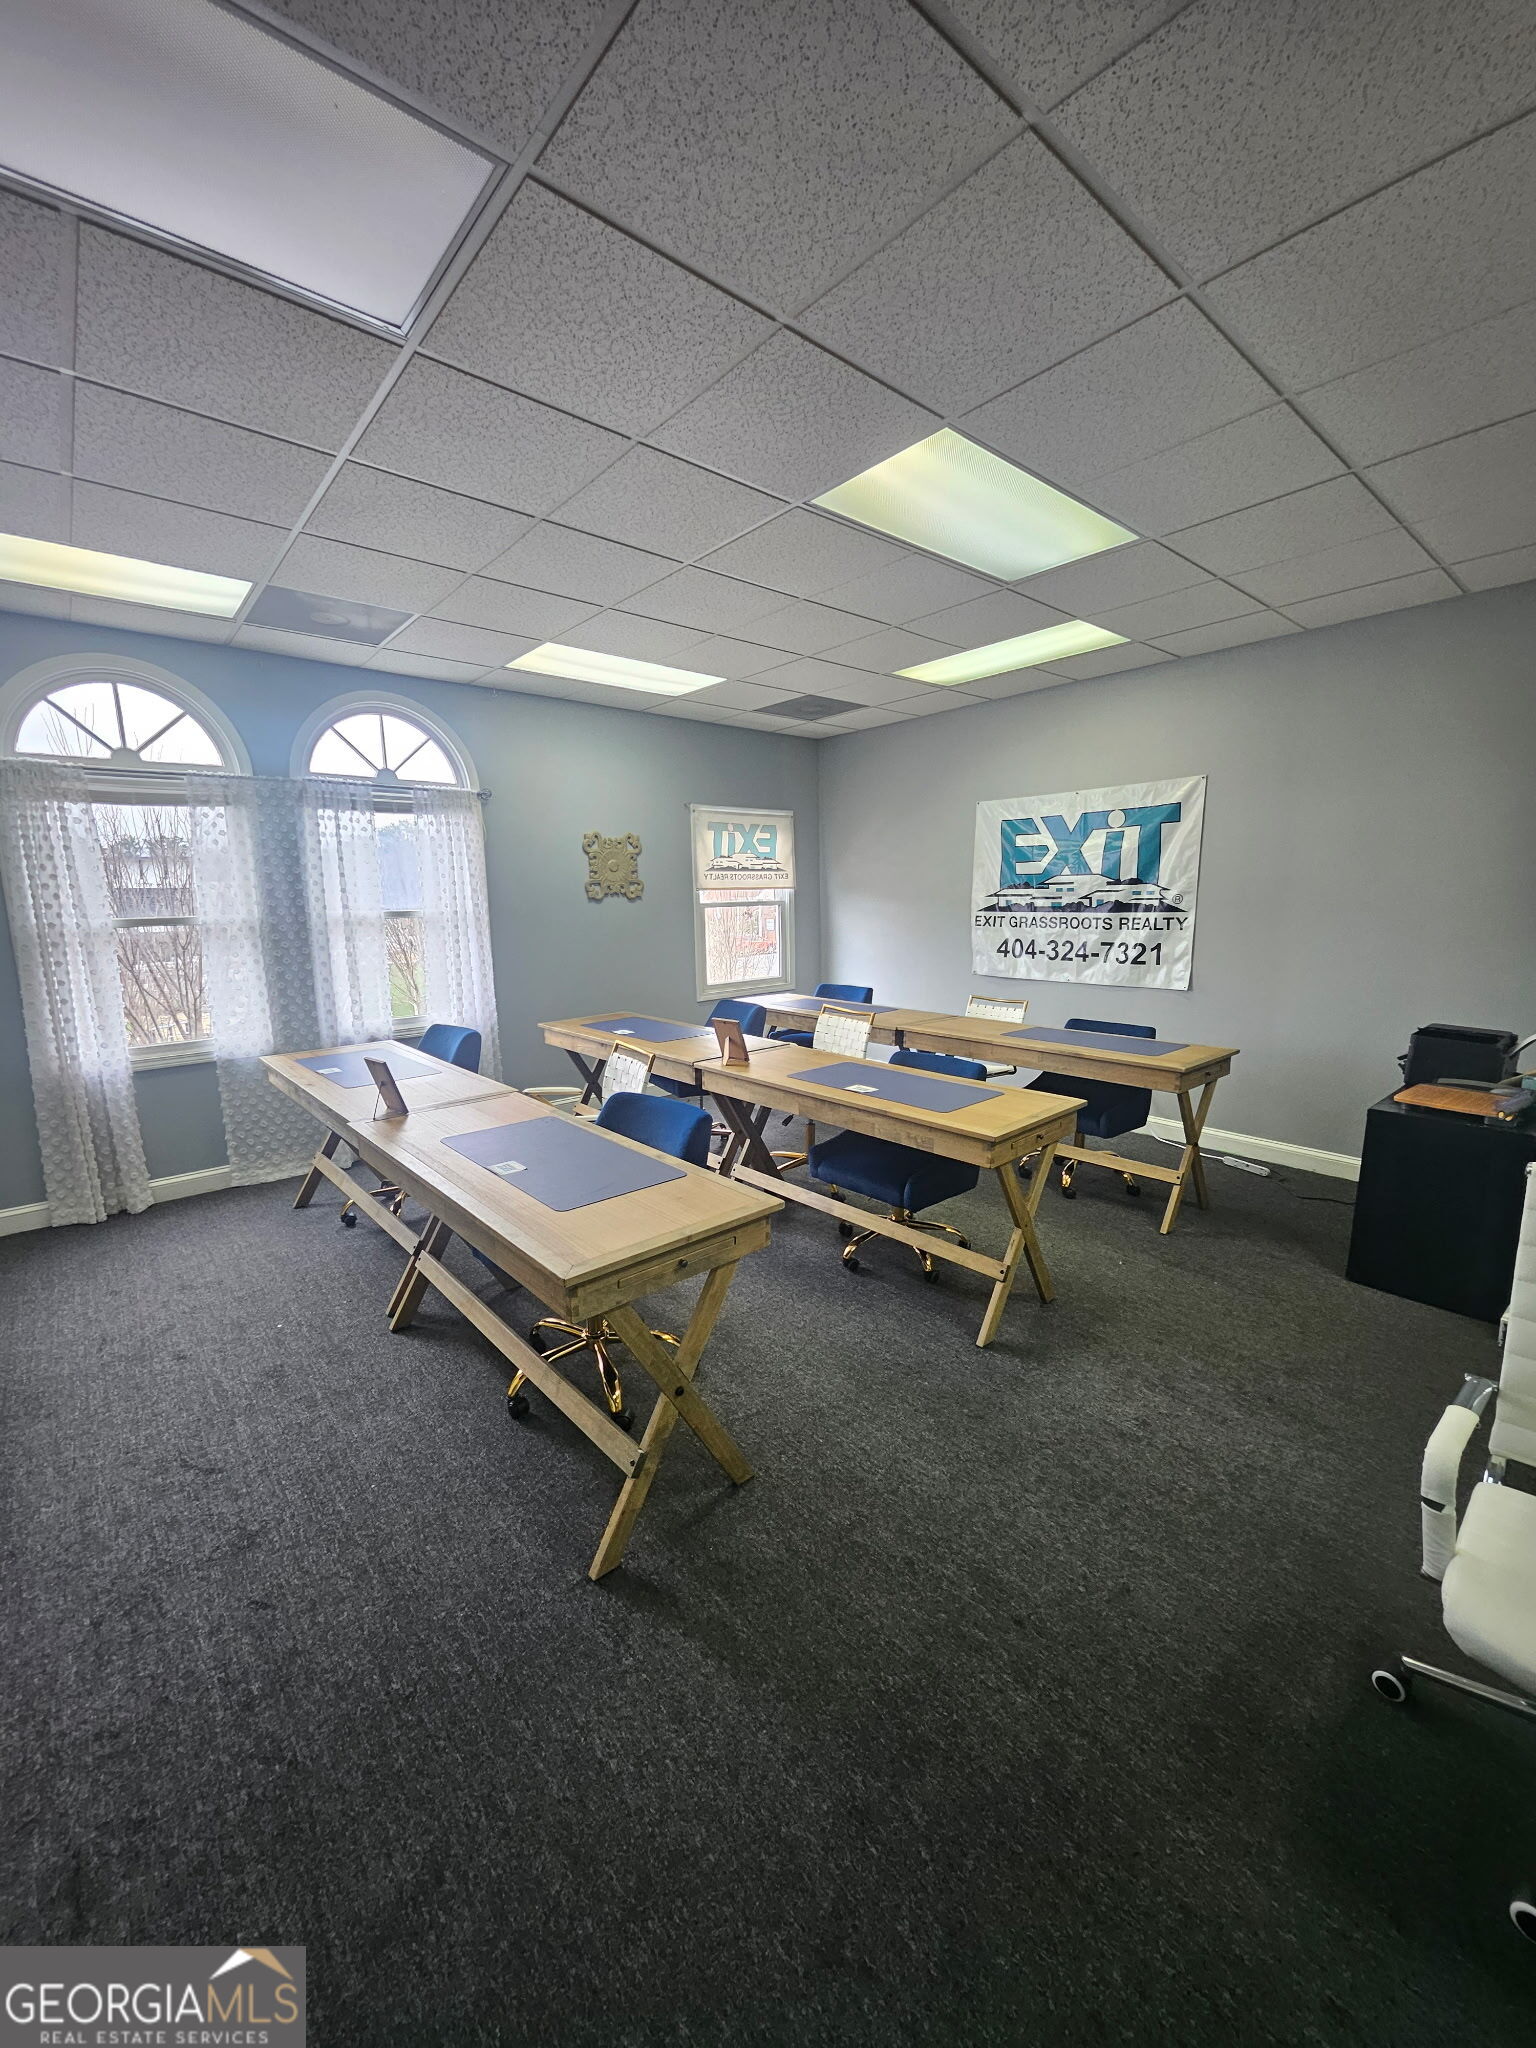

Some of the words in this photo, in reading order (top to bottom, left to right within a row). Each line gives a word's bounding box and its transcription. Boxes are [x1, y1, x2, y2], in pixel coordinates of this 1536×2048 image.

[974, 915, 1006, 928] EXIT
[1009, 915, 1113, 931] GRASSROOTS
[1118, 917, 1189, 931] REALTY
[996, 938, 1163, 966] 404-324-7321
